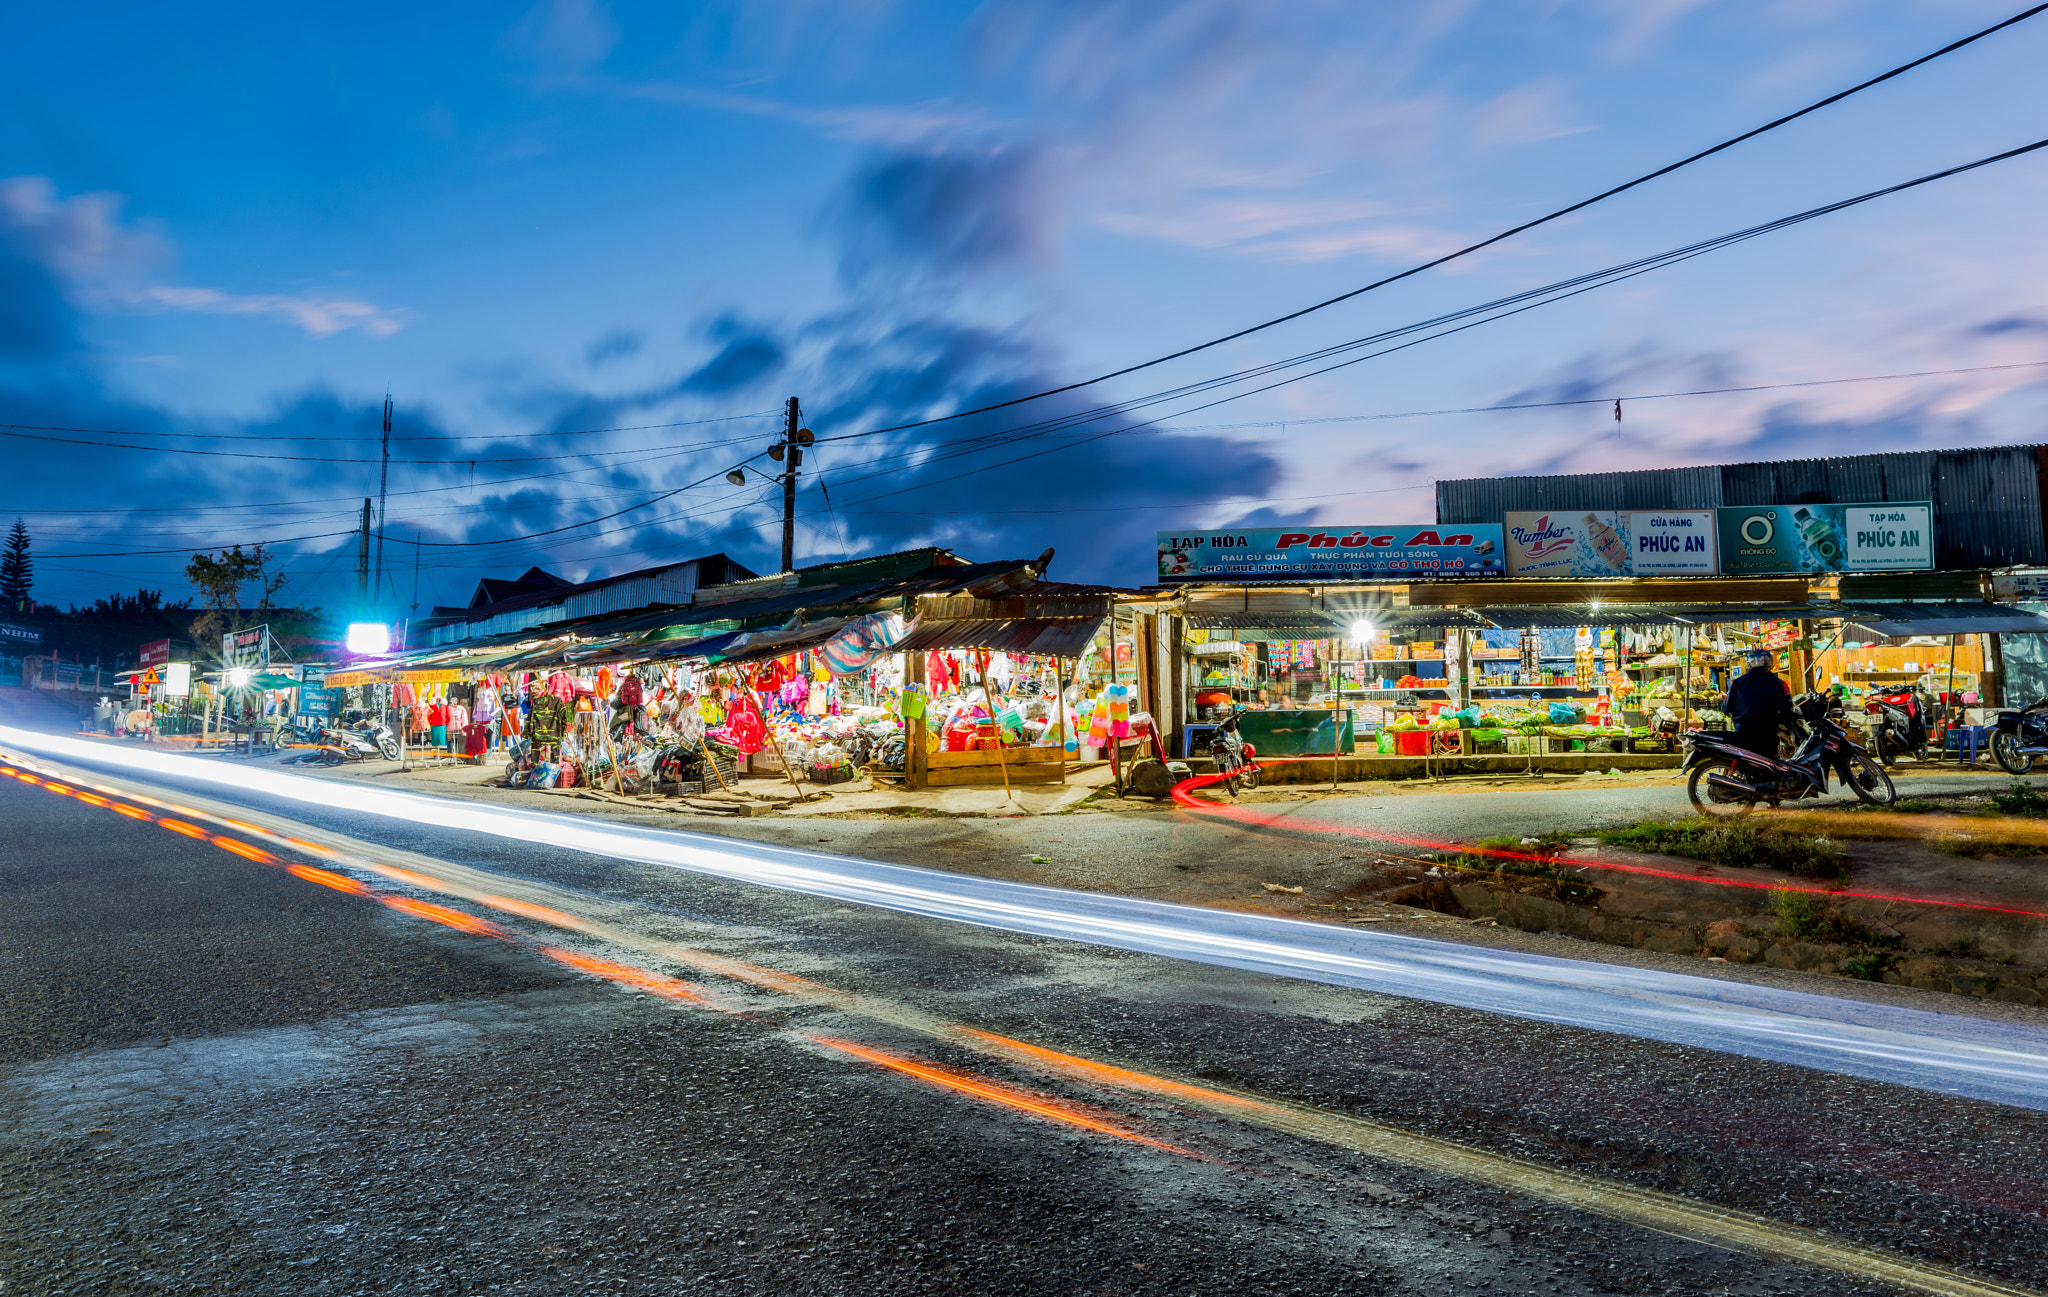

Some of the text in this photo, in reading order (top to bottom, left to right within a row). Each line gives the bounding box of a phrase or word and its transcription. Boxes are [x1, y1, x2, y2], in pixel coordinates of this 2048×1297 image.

[1650, 516, 1692, 527] CỬA HÀNG
[1869, 511, 1906, 524] TẠP HÓA
[1169, 533, 1249, 551] TẠP HÓA
[1275, 530, 1475, 549] Phúc An
[1639, 531, 1680, 552] PHÚC
[1684, 535, 1704, 552] AN
[1857, 526, 1919, 548] PHÚC AN
[1221, 554, 1243, 562] RAU
[1265, 551, 1288, 561] QUẢ
[1310, 549, 1439, 561] THỰC PHẨM TƯƠI SỐNG
[1740, 547, 1764, 555] KHÔNG
[1199, 557, 1465, 574] CHO THUÊ DỤNG CỤ XÂY DỰNG VÀ CÓ THỢ HỒ
[1, 627, 40, 640] NHIM
